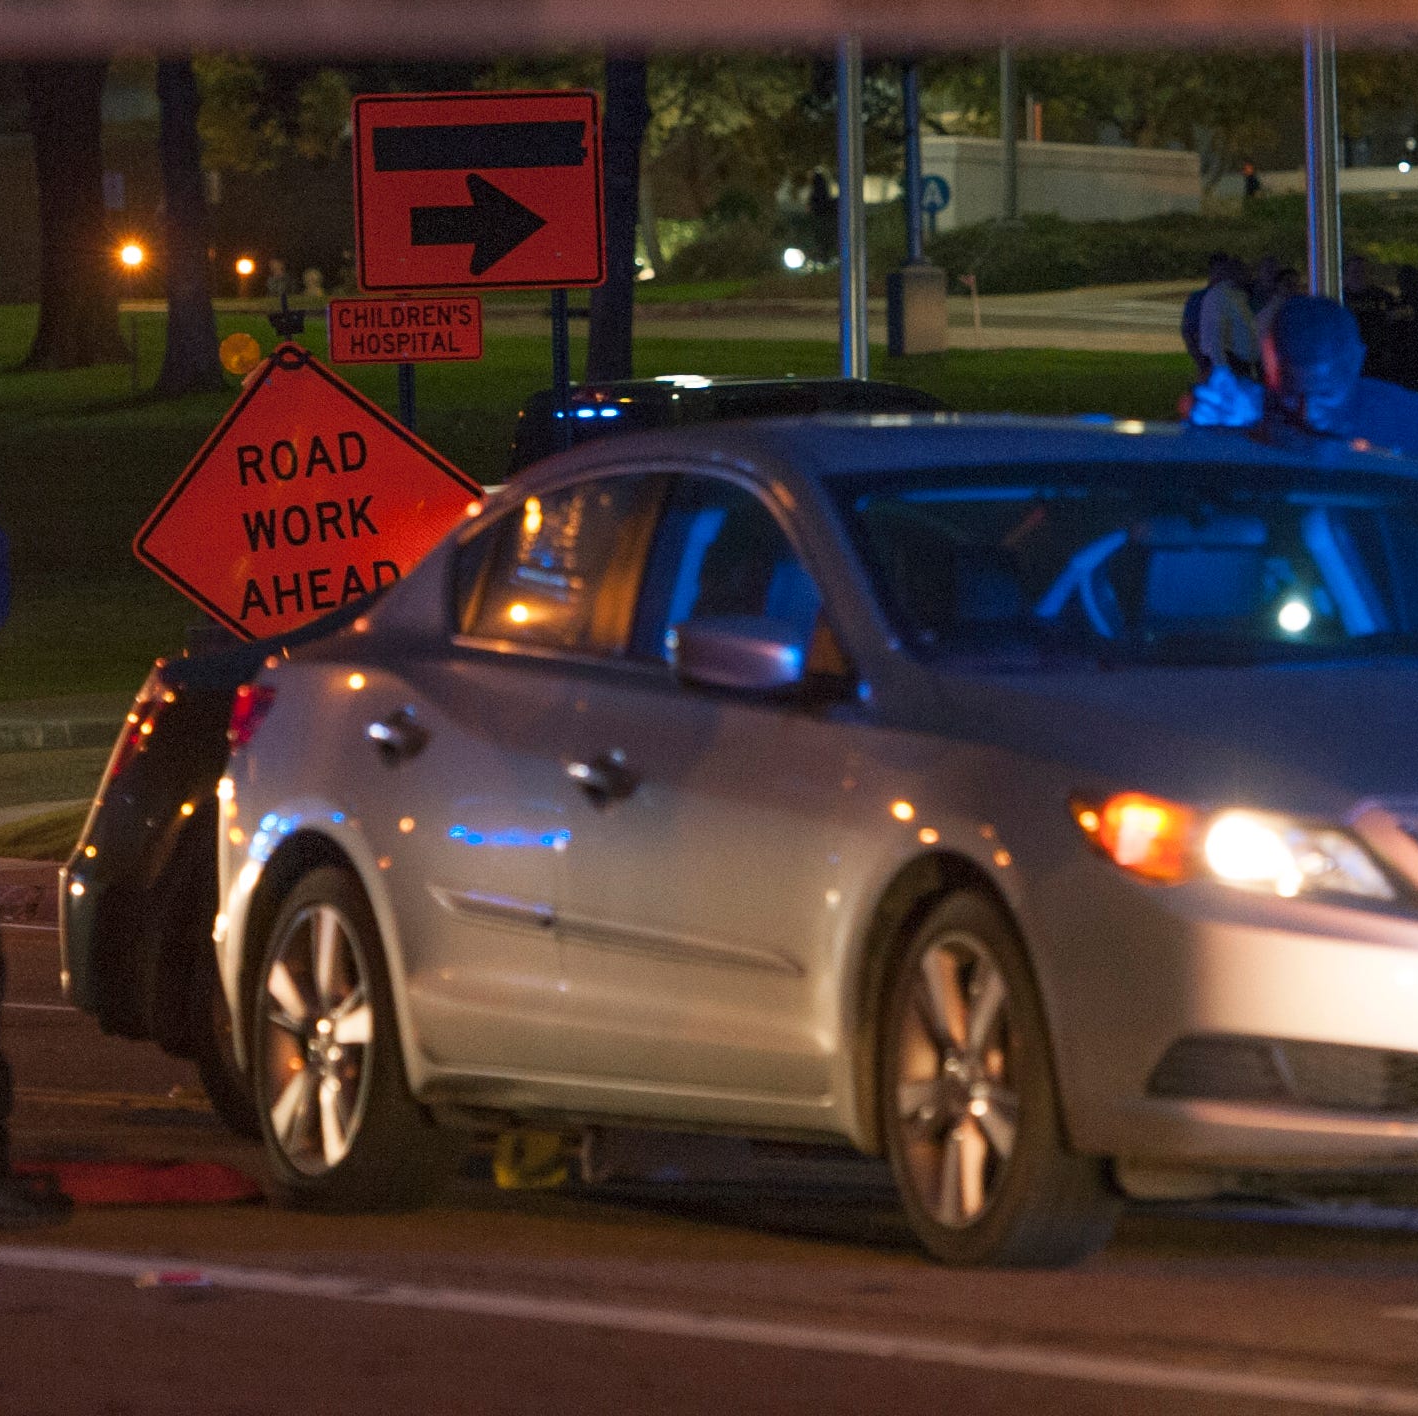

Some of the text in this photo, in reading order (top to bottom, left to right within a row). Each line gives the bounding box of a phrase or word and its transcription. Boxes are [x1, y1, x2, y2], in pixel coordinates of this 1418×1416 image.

[338, 304, 472, 329] CHILDREN'S
[350, 331, 461, 354] HOSPITAL
[237, 431, 368, 486] ROAD
[241, 495, 380, 553] WORK
[239, 560, 401, 621] AHEAD
